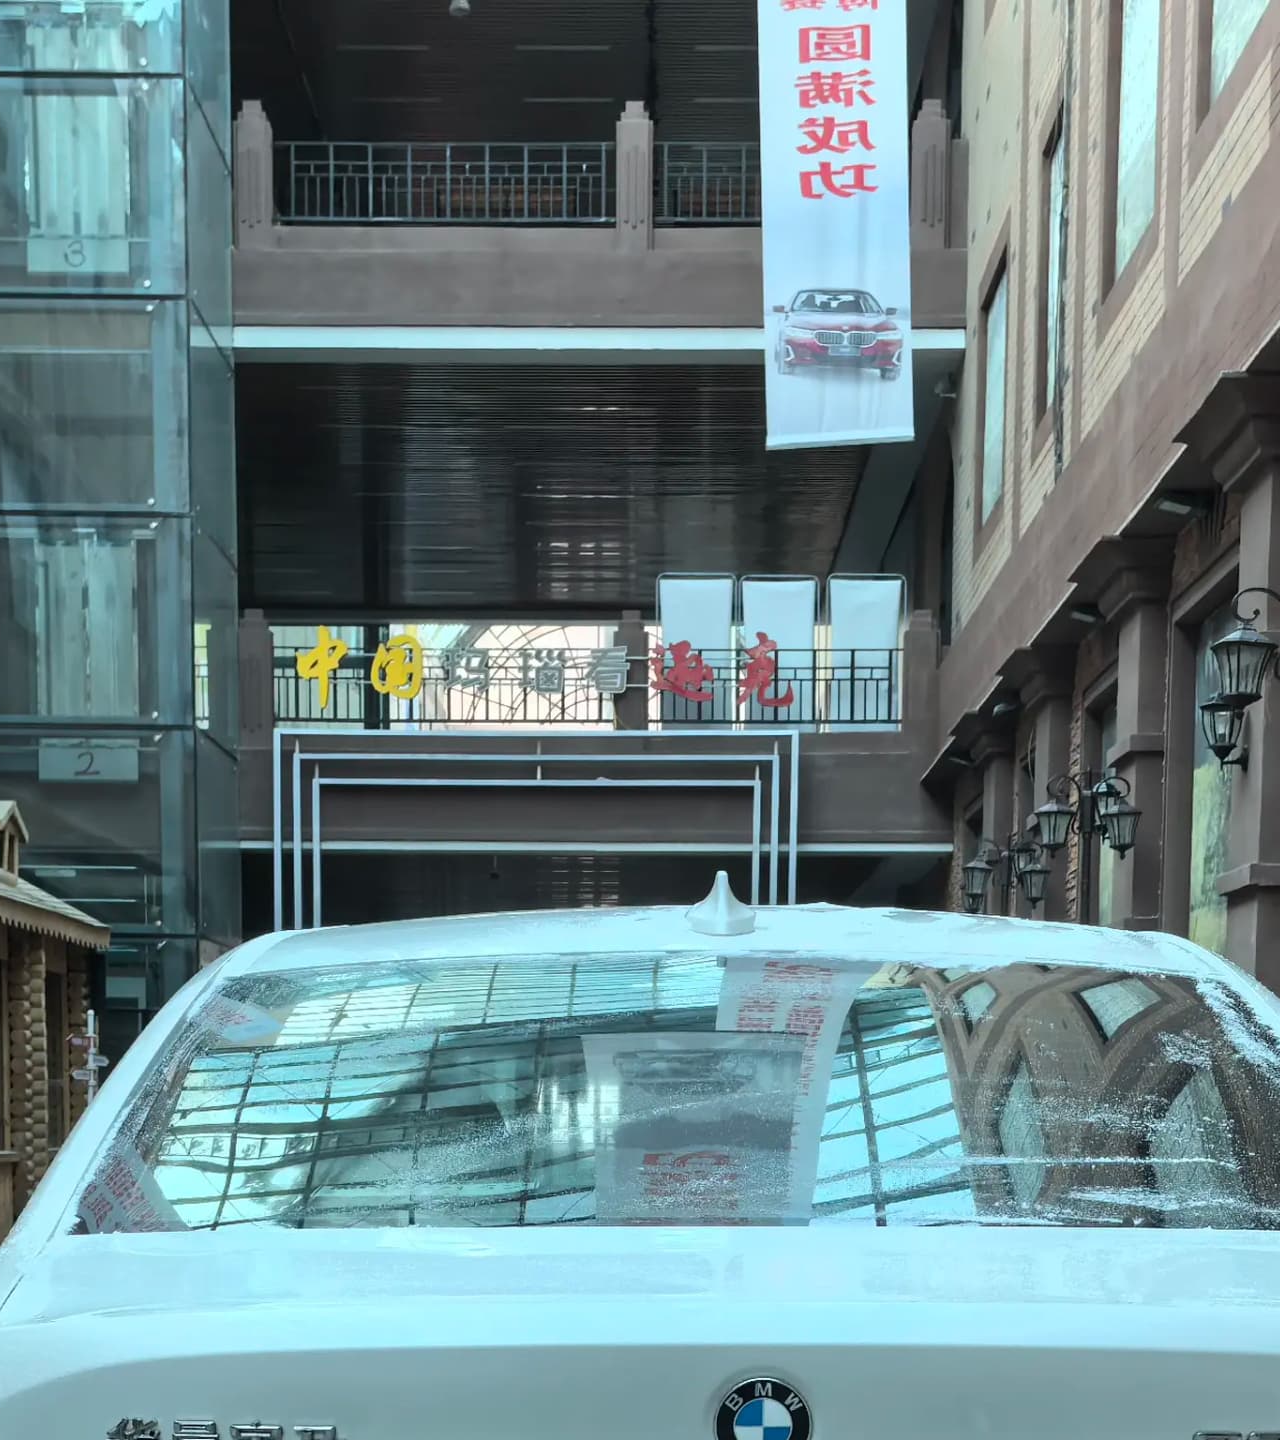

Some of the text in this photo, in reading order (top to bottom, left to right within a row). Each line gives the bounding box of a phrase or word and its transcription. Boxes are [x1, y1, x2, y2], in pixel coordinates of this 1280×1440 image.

[64, 240, 86, 267] 3
[74, 751, 100, 776] 2
[724, 1382, 803, 1412] BMW
